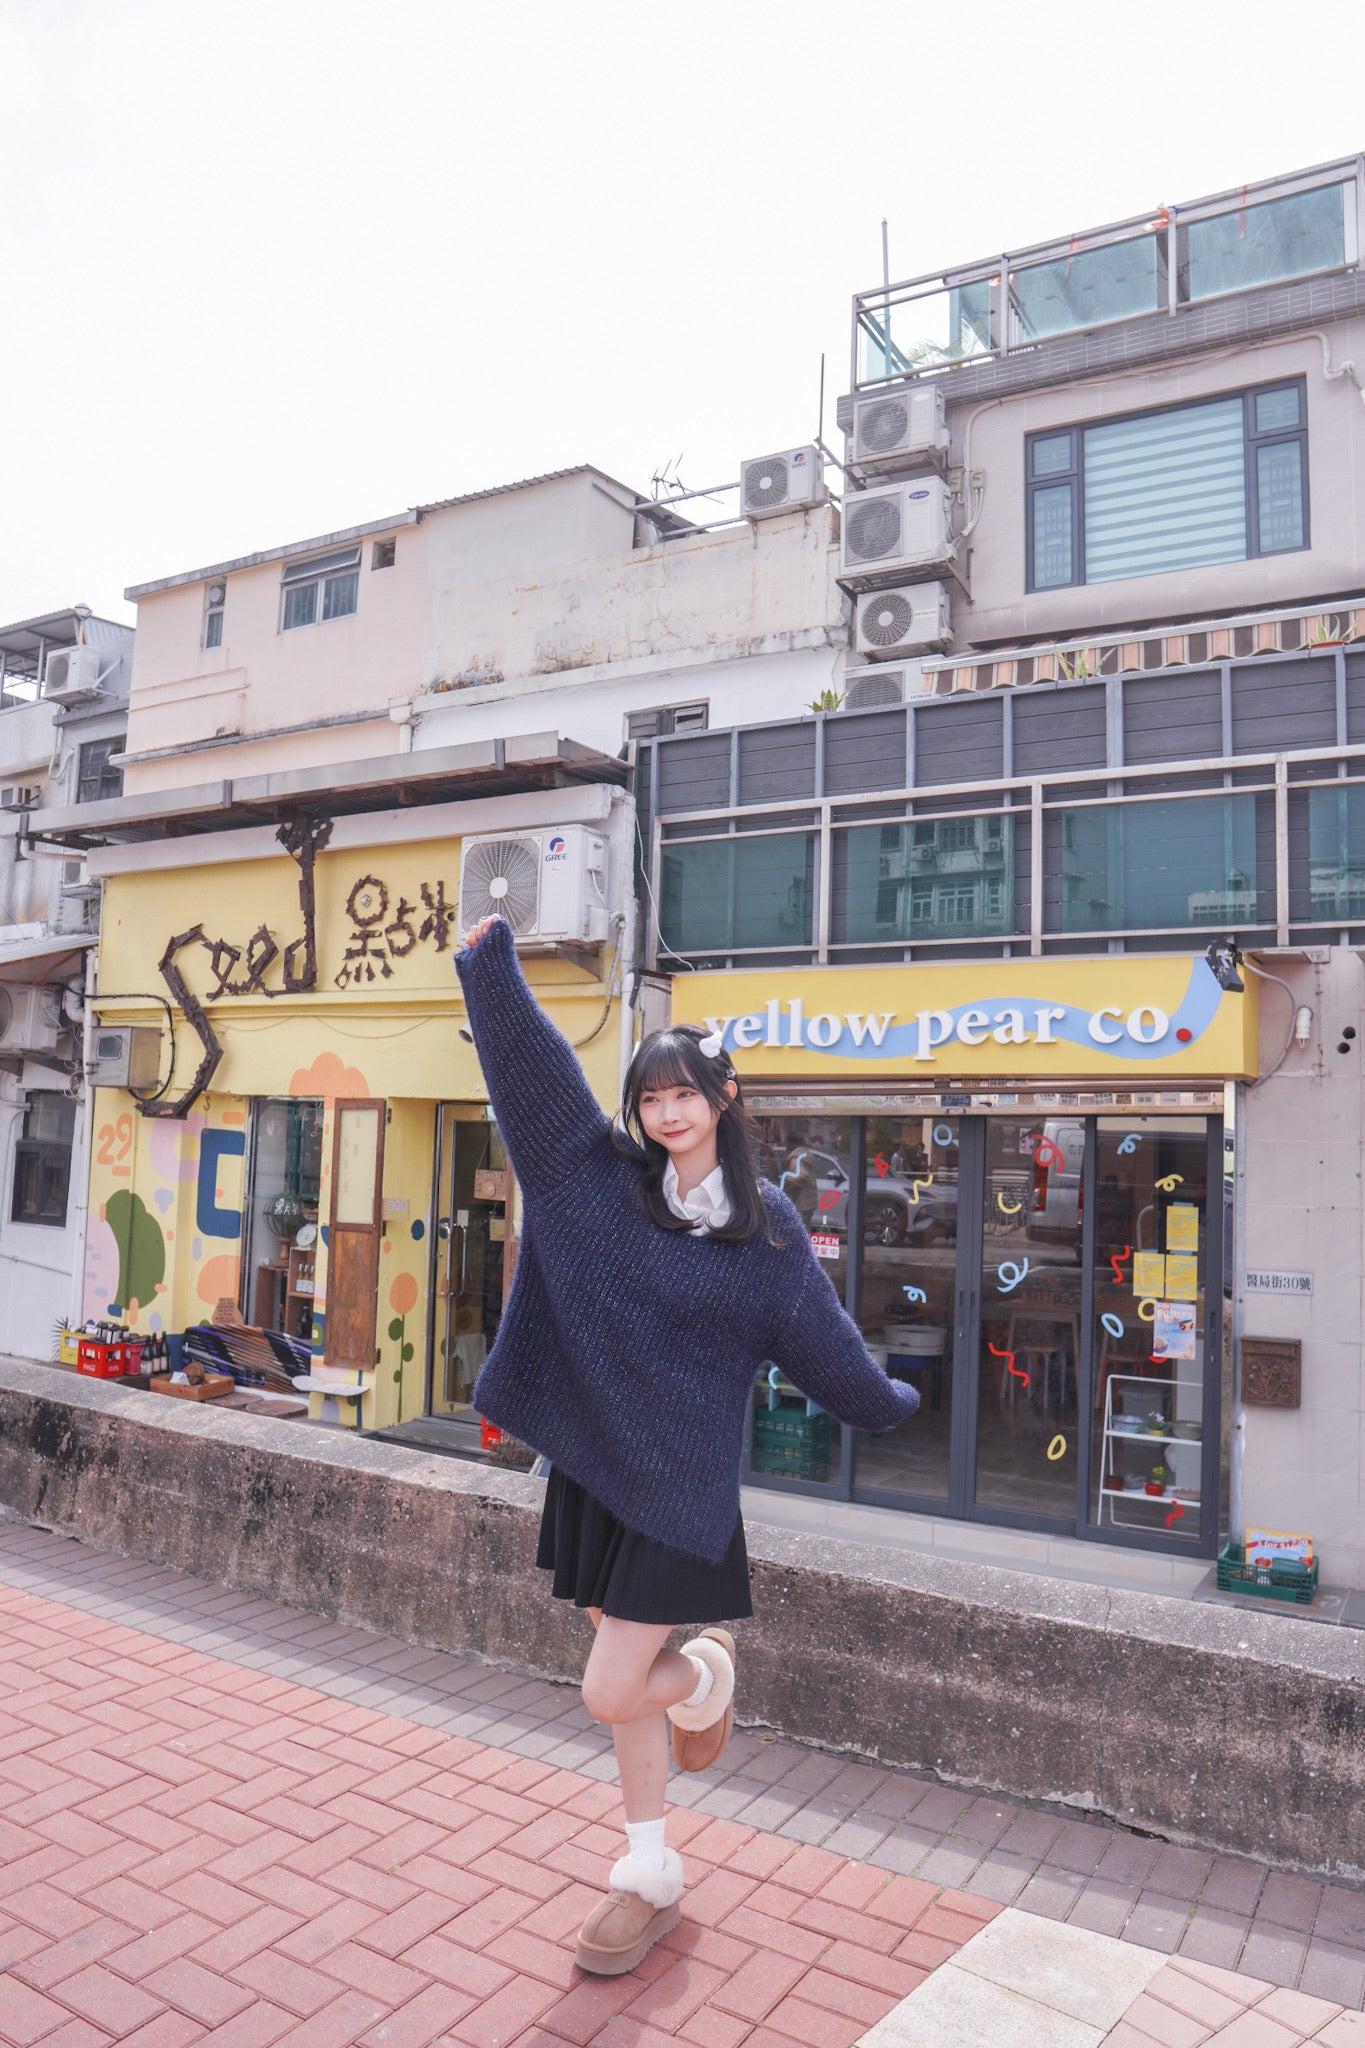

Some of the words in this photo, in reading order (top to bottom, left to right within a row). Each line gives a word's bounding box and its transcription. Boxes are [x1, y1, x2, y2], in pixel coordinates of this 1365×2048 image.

[545, 853, 569, 862] GREE
[137, 811, 333, 1120] Seed
[702, 998, 897, 1048] yellow
[913, 1002, 1066, 1062] pear
[1088, 1005, 1192, 1046] co.
[97, 1113, 133, 1165] 29
[811, 1235, 839, 1245] OPEN
[1246, 1274, 1311, 1291] 醫局街30號
[1263, 1540, 1278, 1548] for
